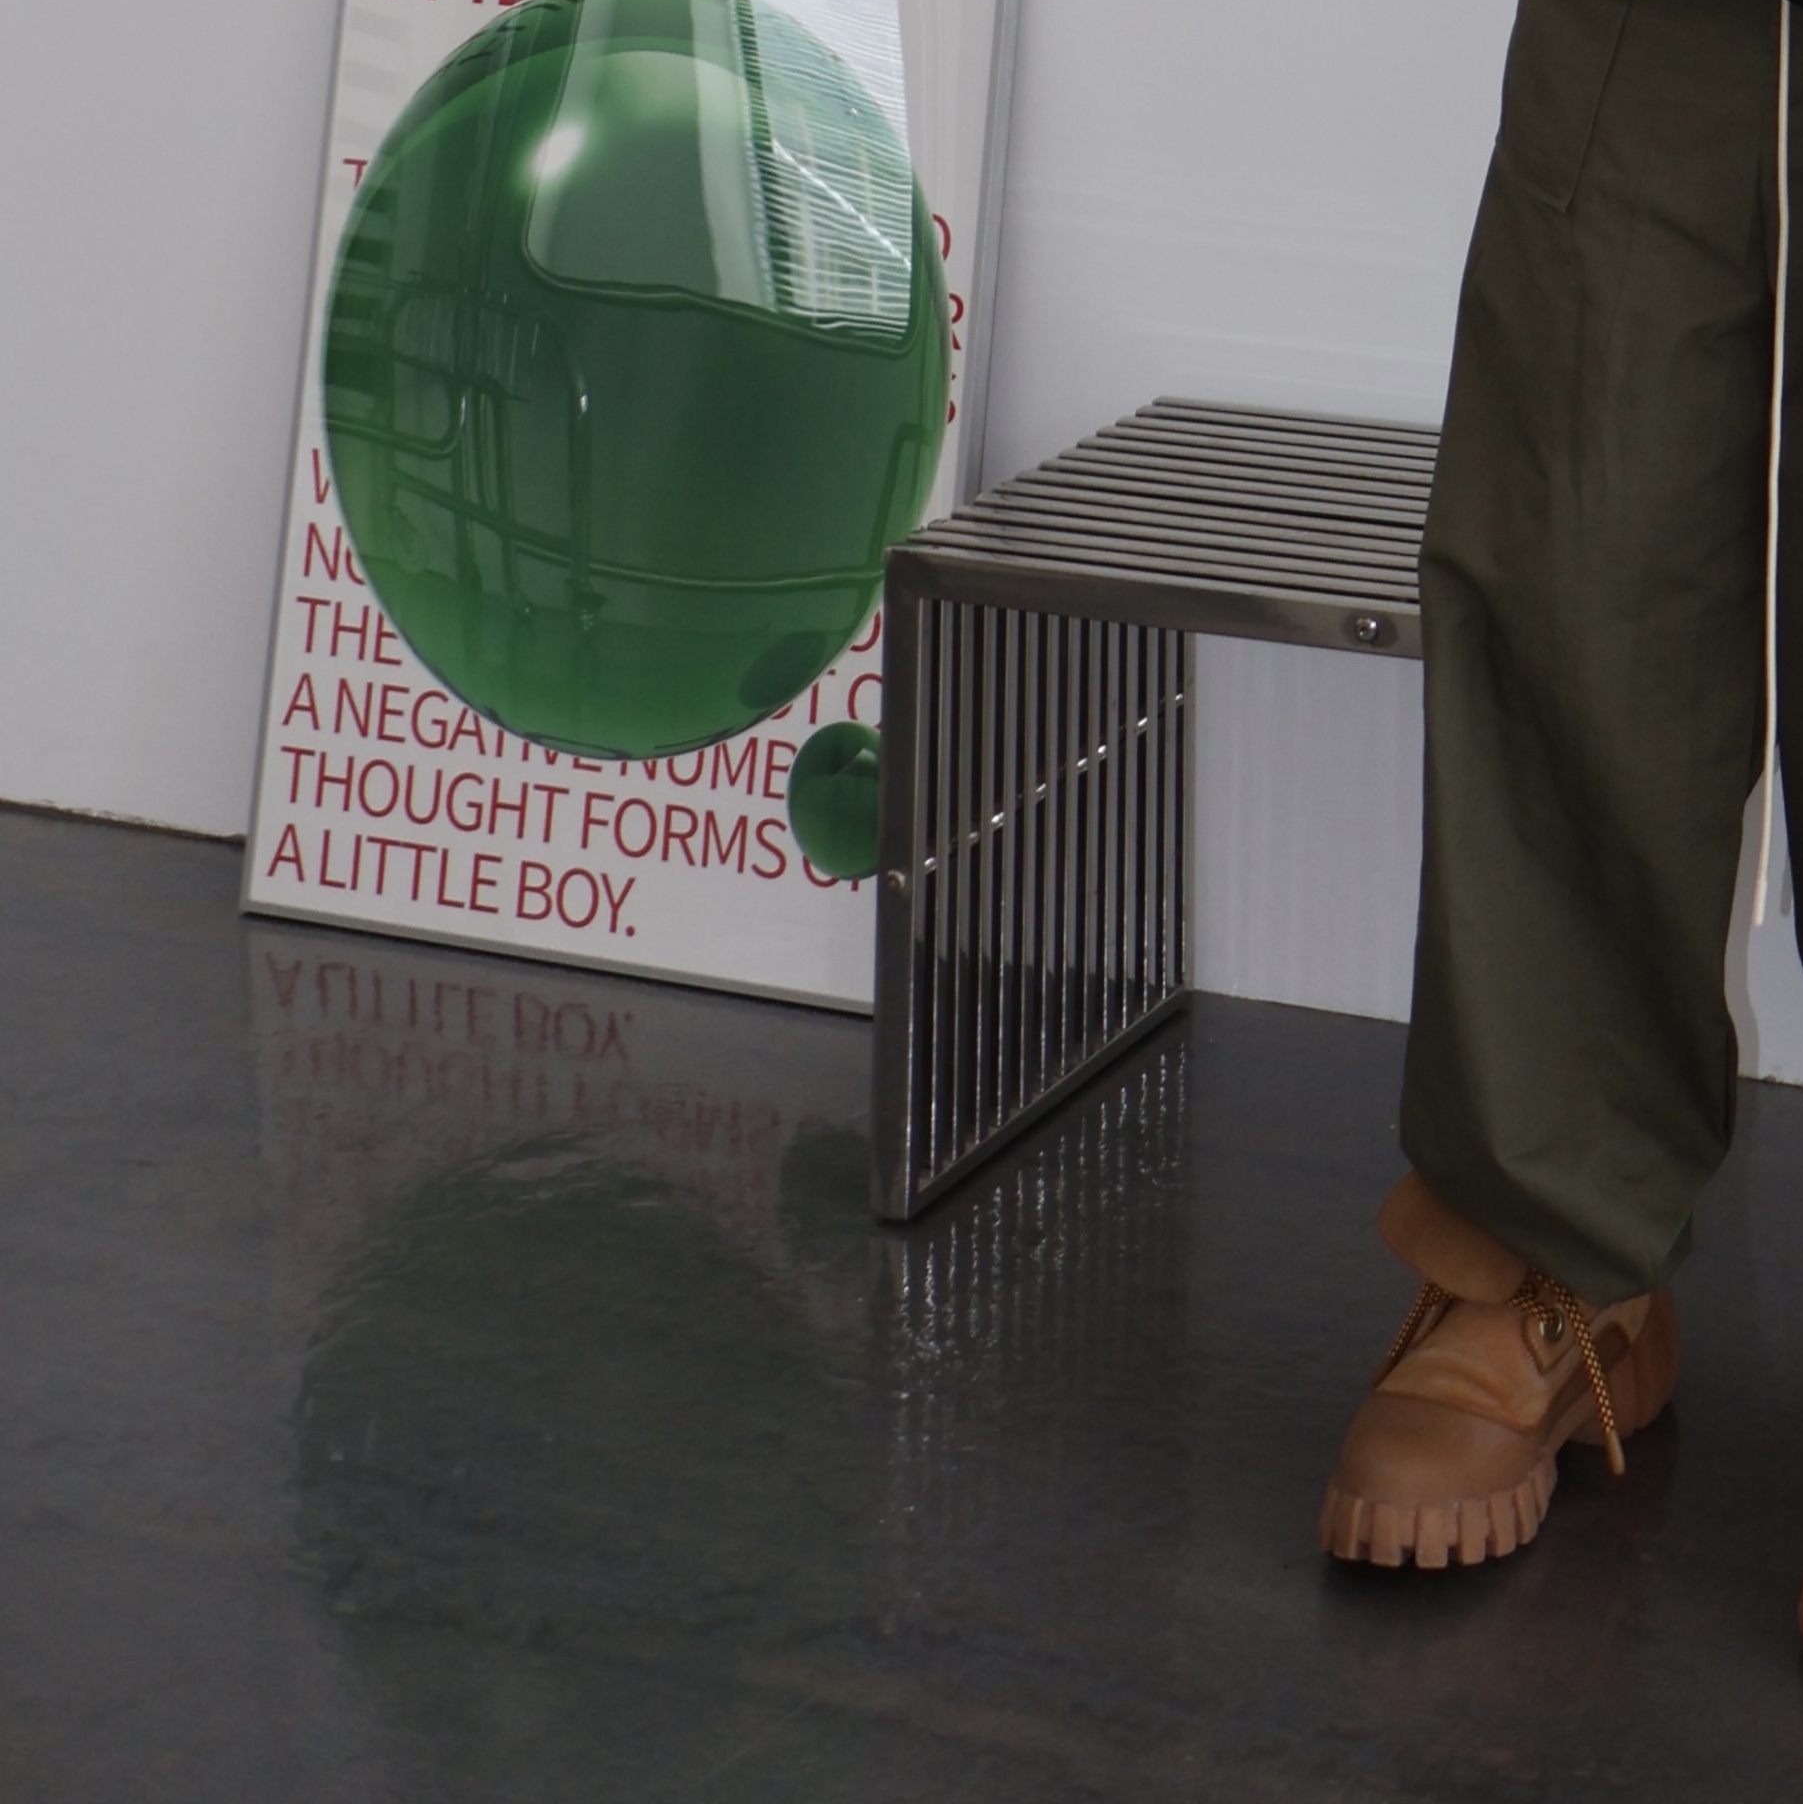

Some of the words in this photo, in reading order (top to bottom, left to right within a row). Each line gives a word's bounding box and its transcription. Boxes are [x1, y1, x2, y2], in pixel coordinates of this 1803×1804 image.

[298, 596, 403, 667] THE
[283, 673, 320, 730] A
[281, 746, 569, 841] THOUGHT
[580, 792, 788, 880] FORMS
[267, 823, 305, 882] A
[318, 829, 502, 915] LITTLE
[515, 861, 636, 937] BOY.
